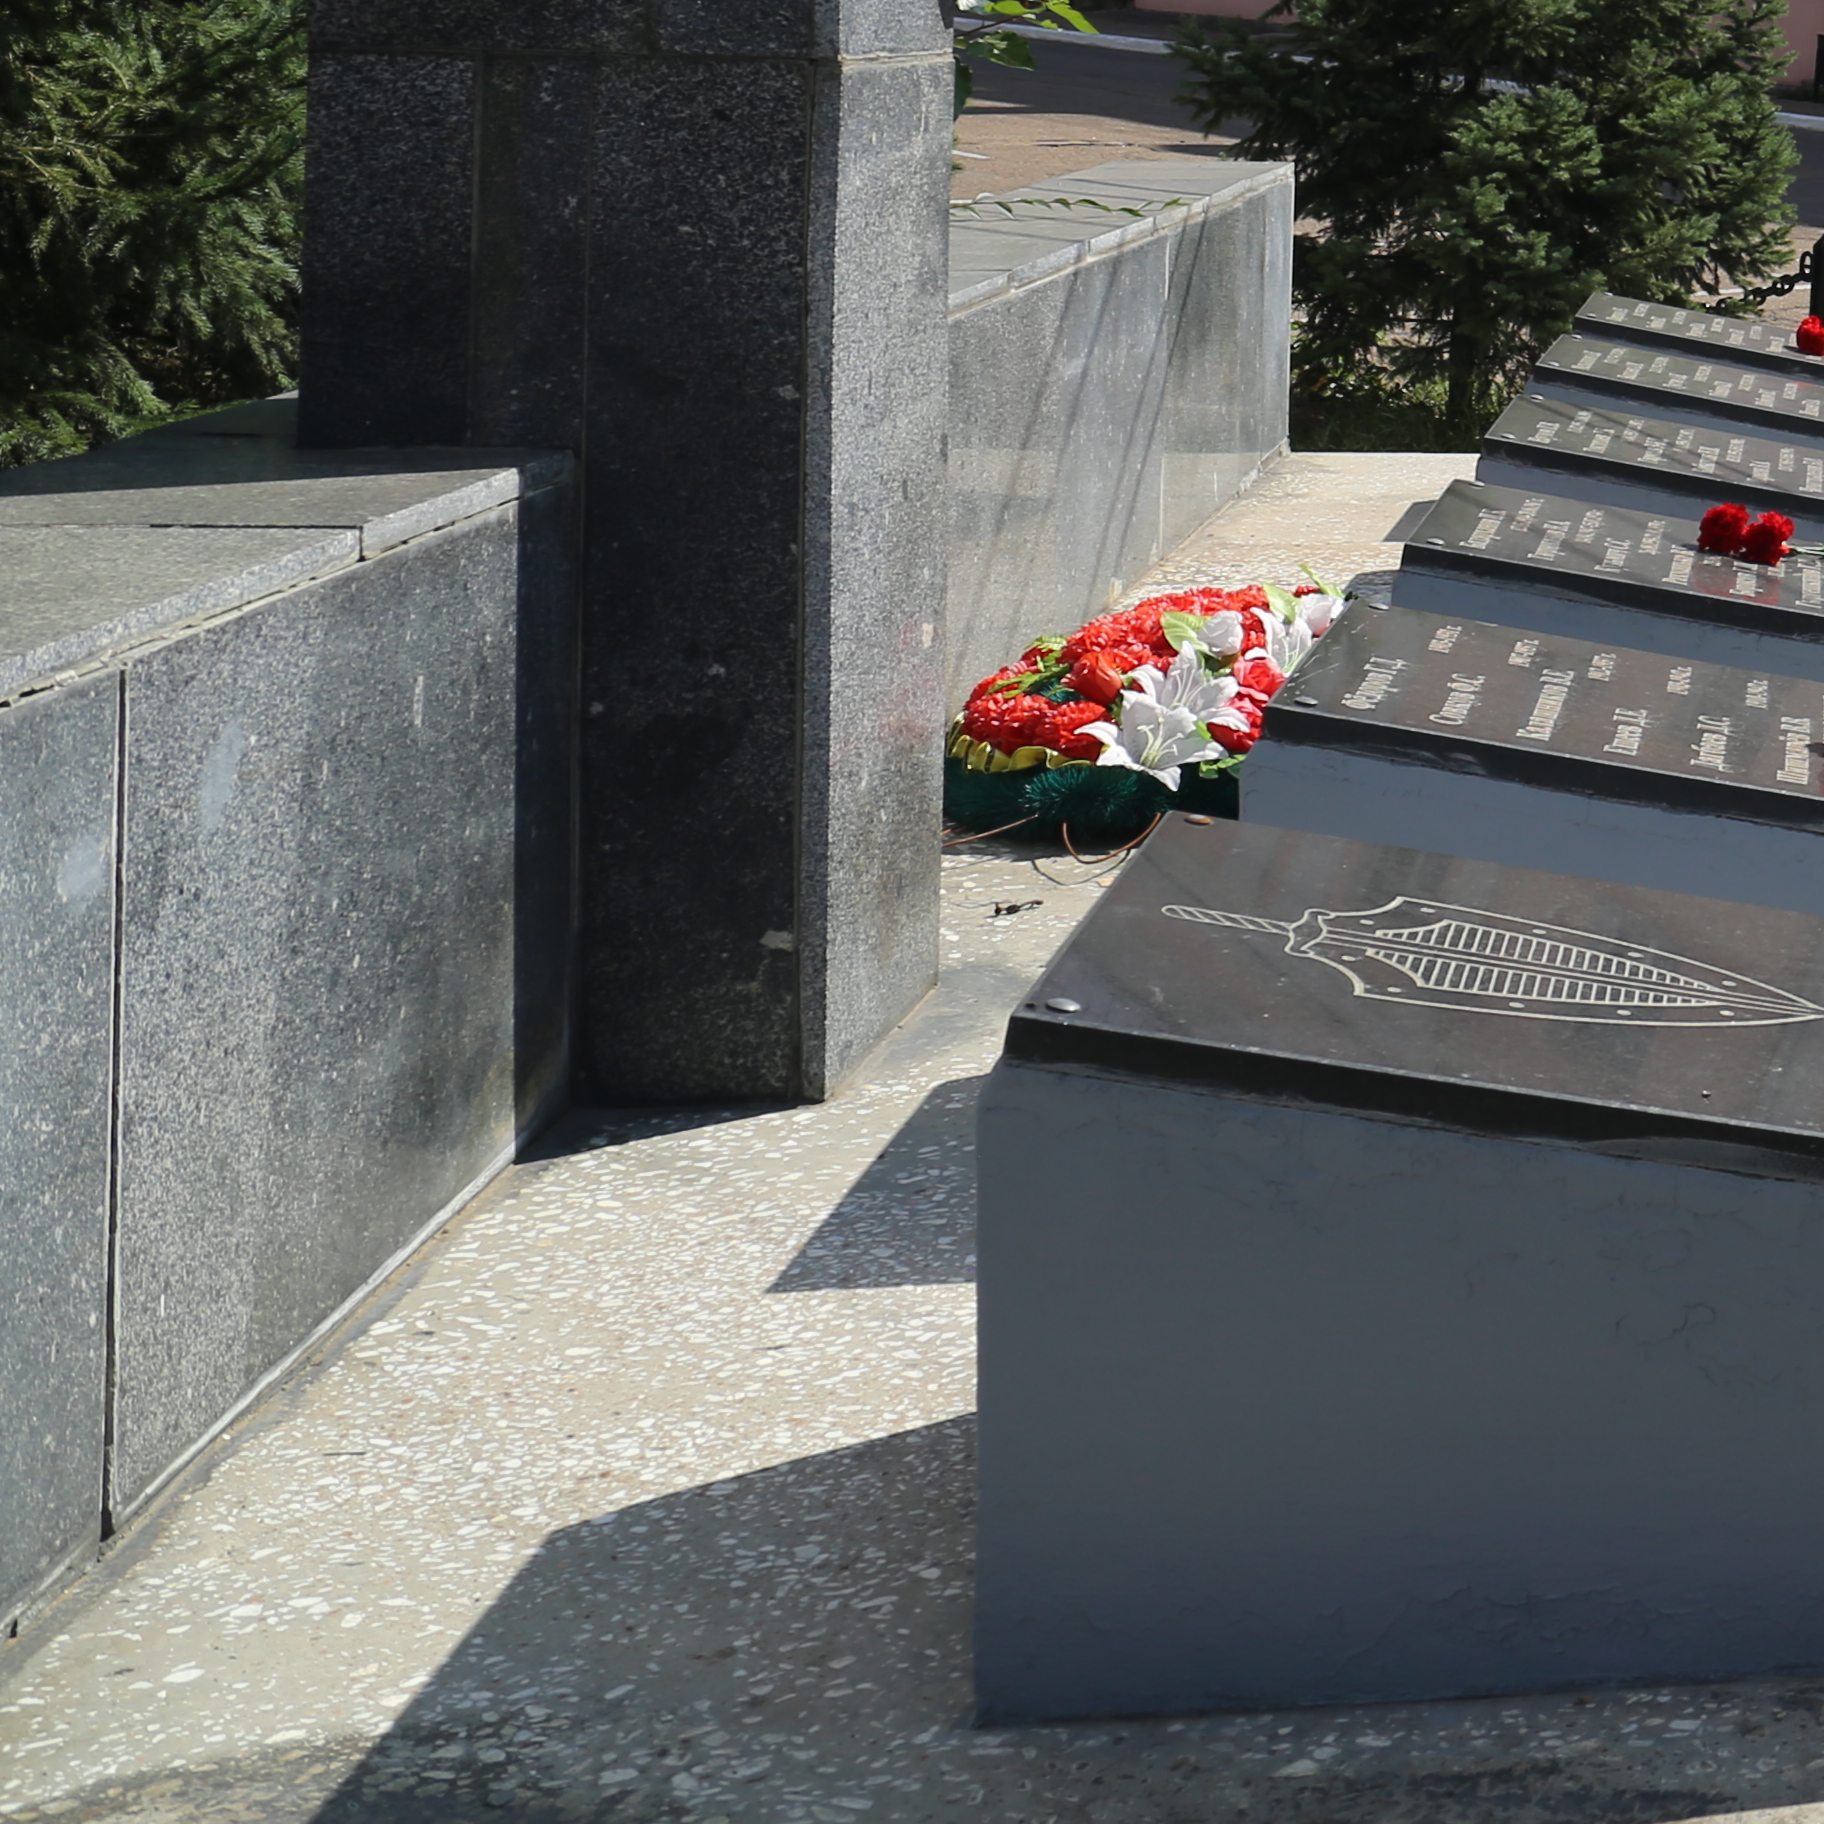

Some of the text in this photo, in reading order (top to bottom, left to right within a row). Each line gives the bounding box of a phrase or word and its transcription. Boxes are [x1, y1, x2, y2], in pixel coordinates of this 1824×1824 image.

[1342, 672, 1398, 708] Фёдоров
[1429, 691, 1477, 724] Совков
[1517, 684, 1567, 739] Калашников
